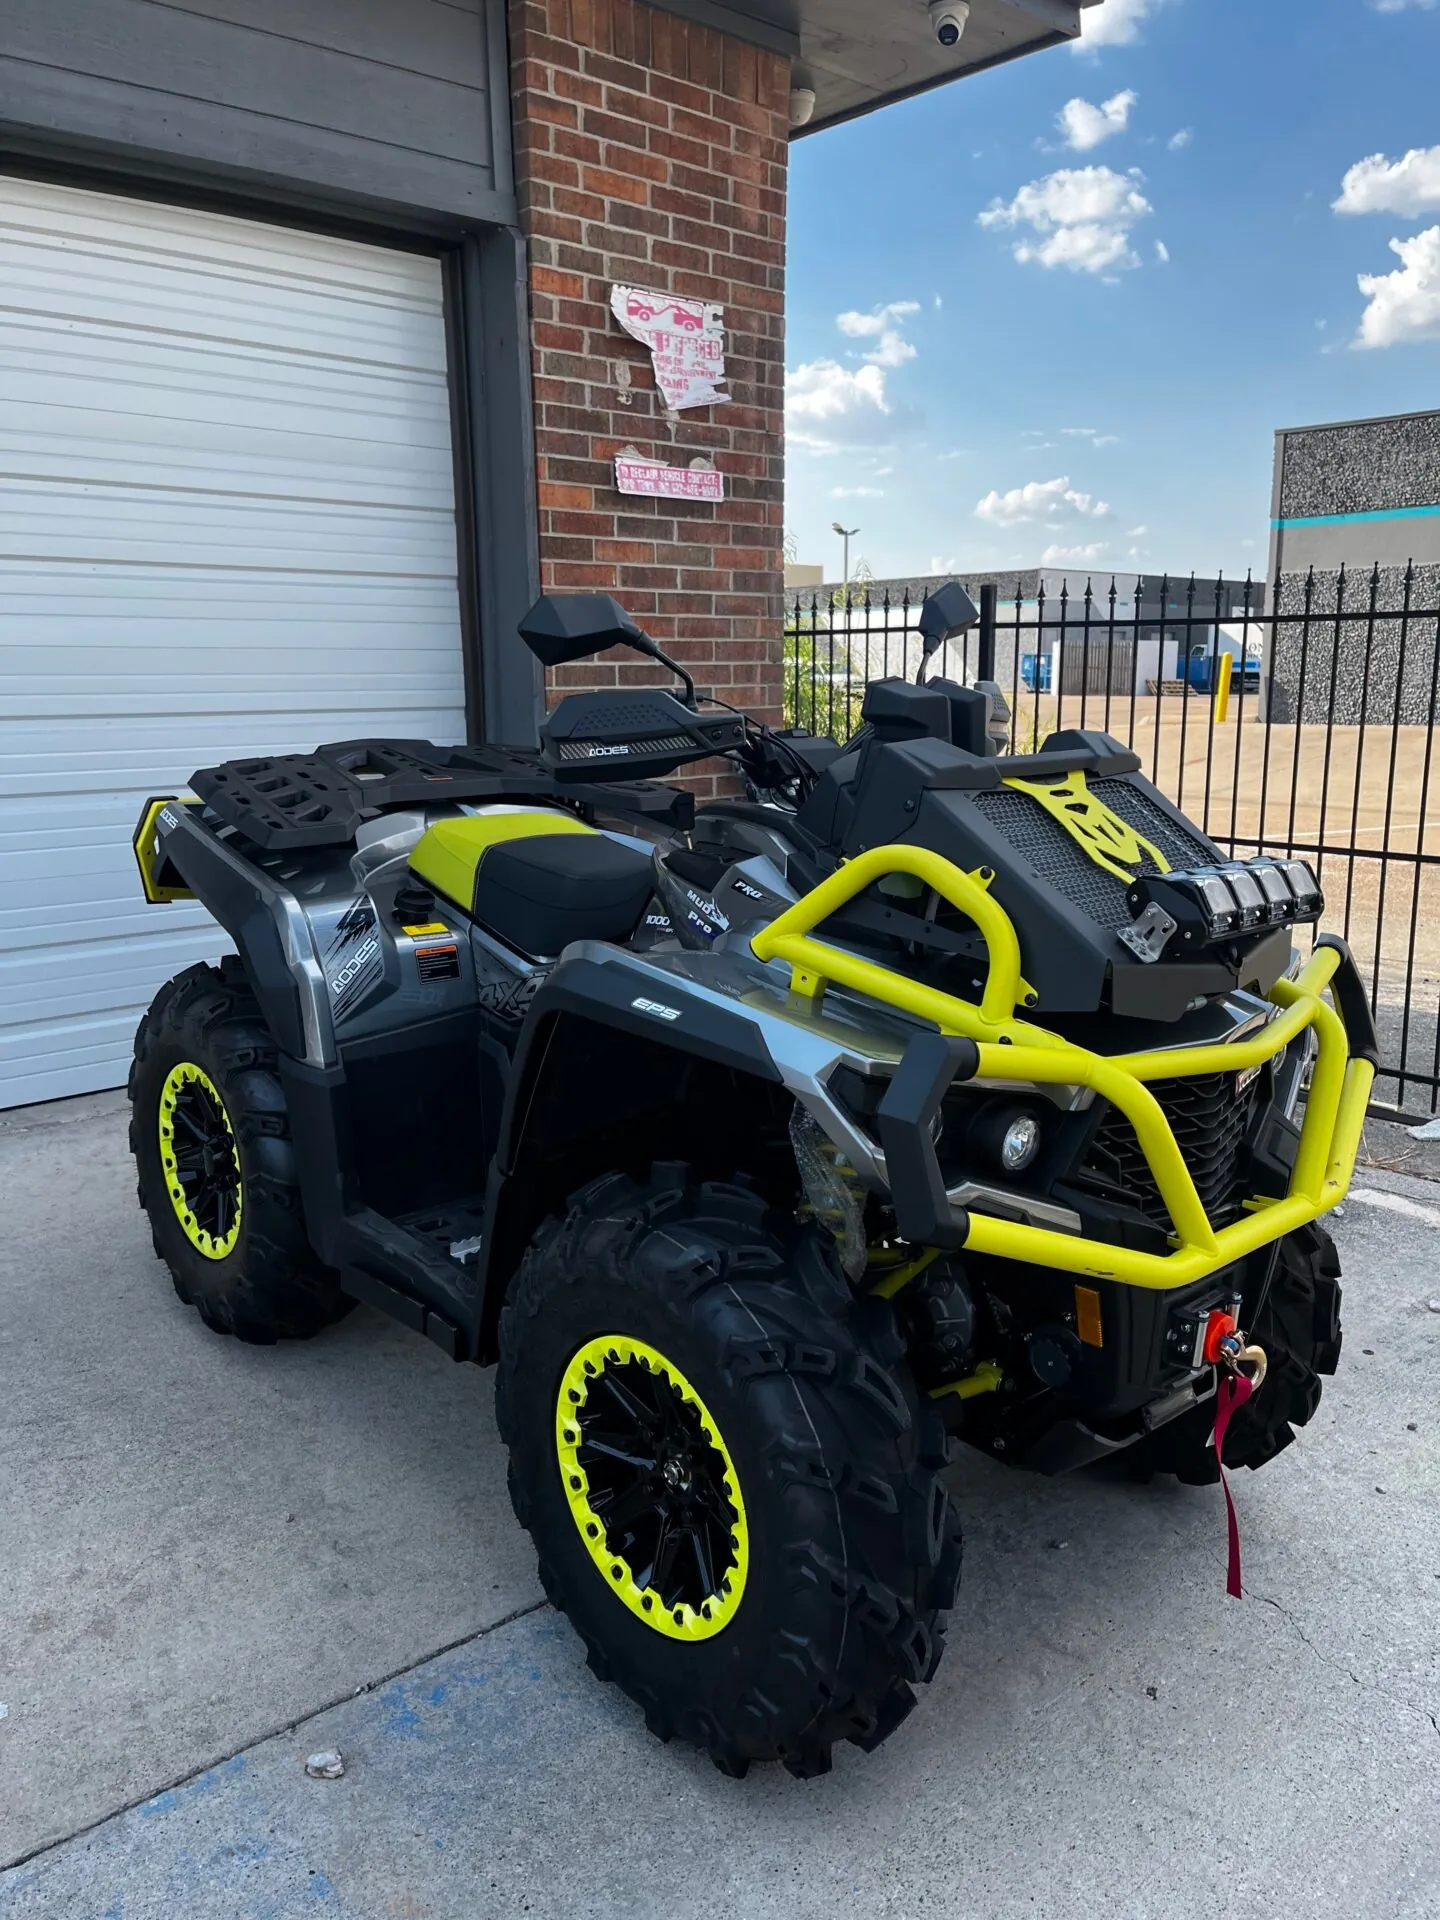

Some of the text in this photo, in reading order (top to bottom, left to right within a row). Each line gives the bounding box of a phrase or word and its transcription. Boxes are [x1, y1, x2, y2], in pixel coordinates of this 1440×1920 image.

[590, 745, 629, 757] AODES
[687, 889, 712, 915] MUD
[735, 881, 763, 899] PRO
[646, 914, 671, 926] 1000
[688, 910, 712, 934] Pro
[331, 937, 379, 995] AODES
[630, 997, 683, 1021] EPS
